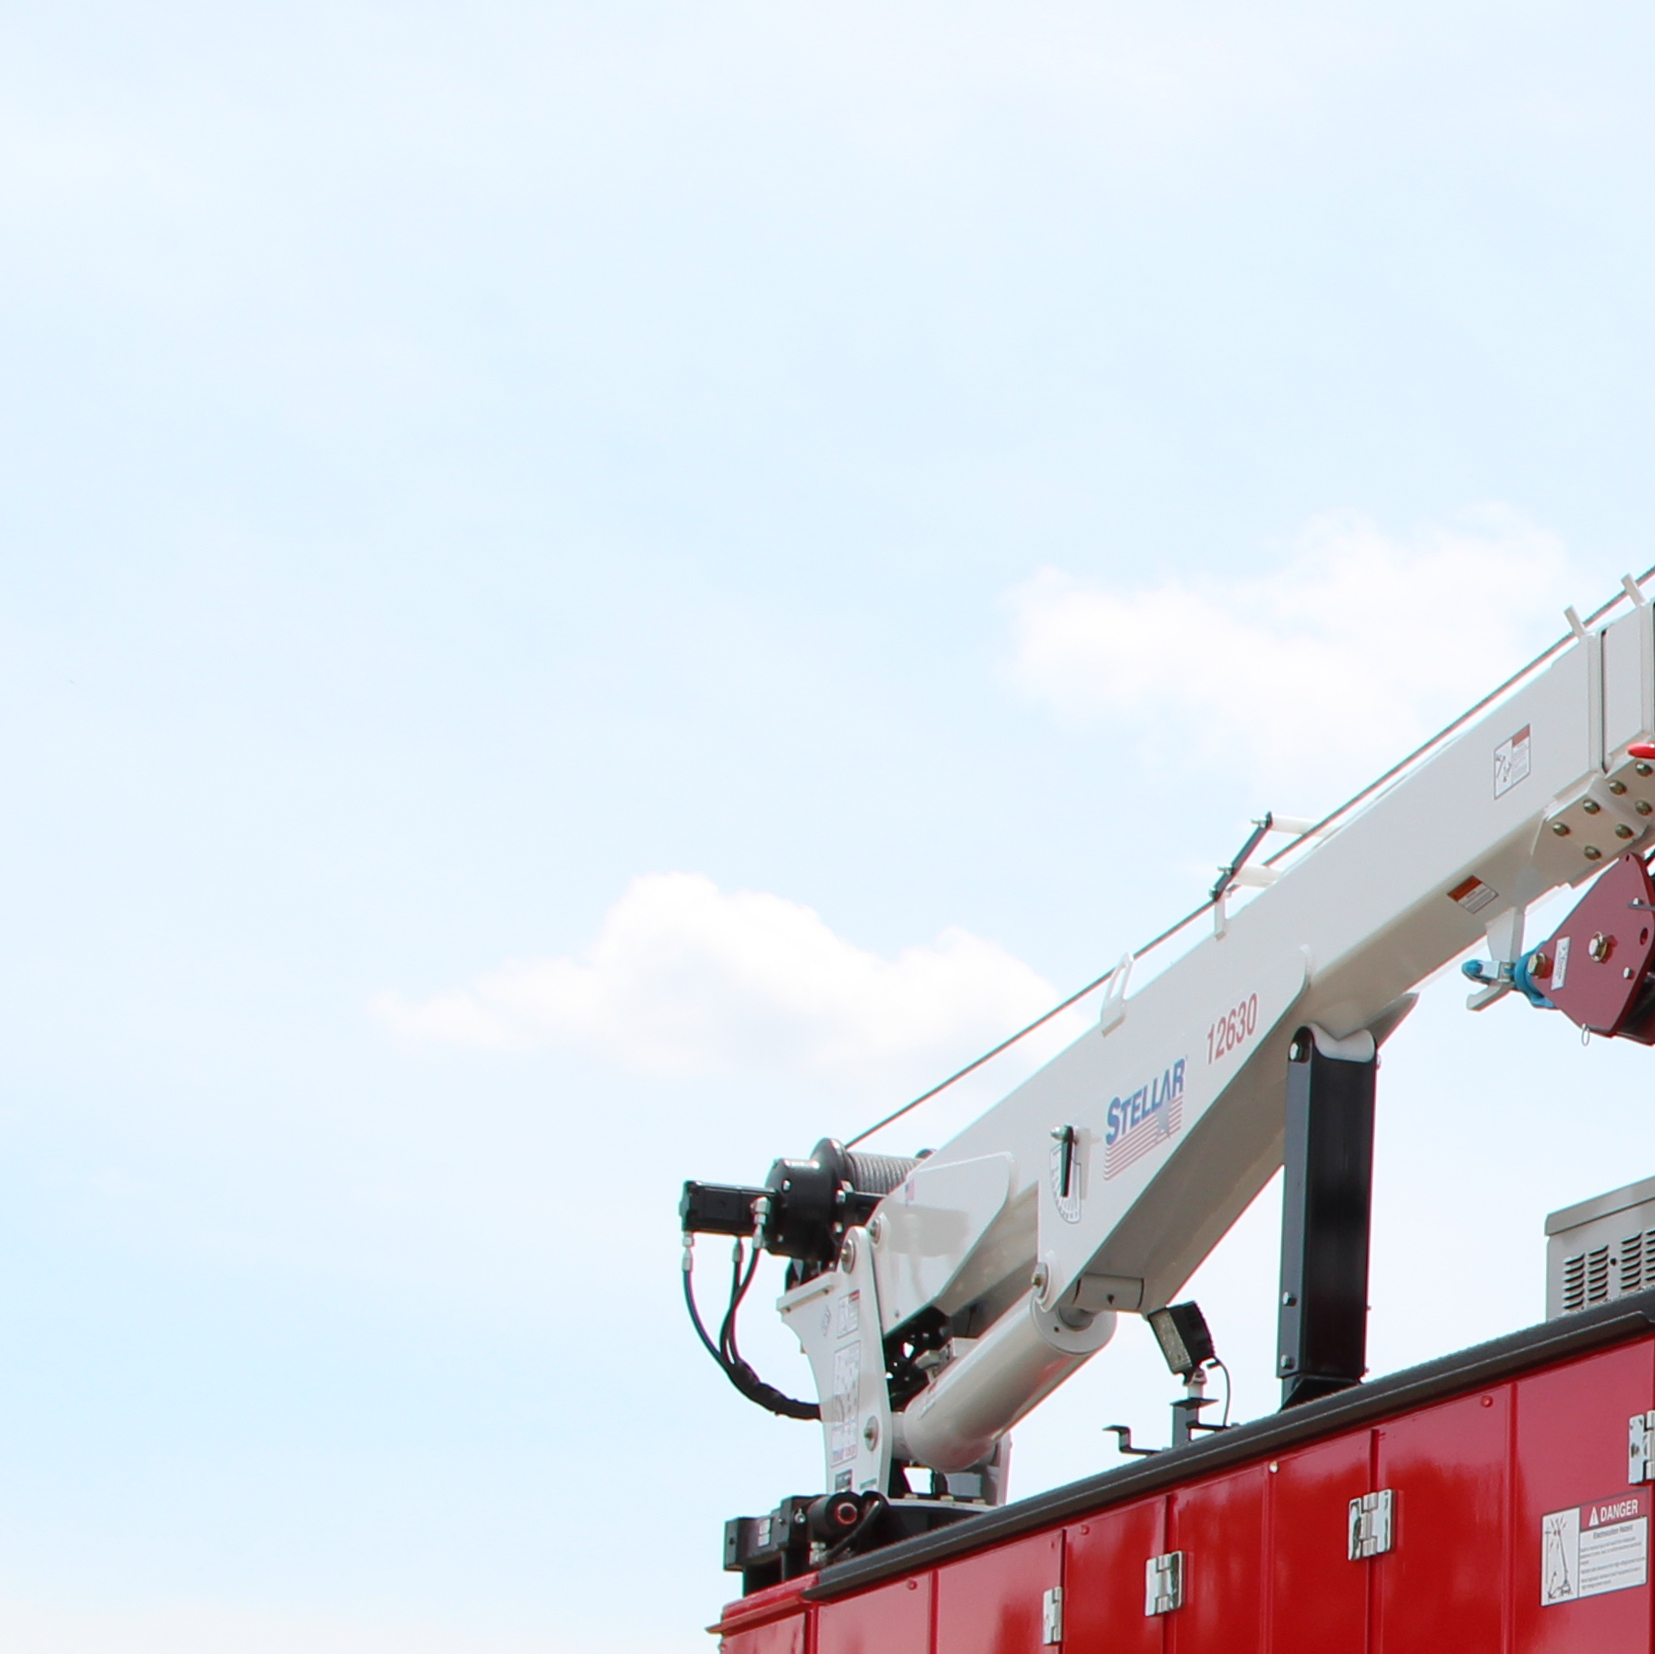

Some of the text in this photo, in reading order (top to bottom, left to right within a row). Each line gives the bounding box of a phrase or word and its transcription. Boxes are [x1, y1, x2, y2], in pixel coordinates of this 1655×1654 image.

[1207, 993, 1257, 1064] 12630
[1106, 1058, 1185, 1145] STELLAR
[1600, 1499, 1638, 1522] DANGER
